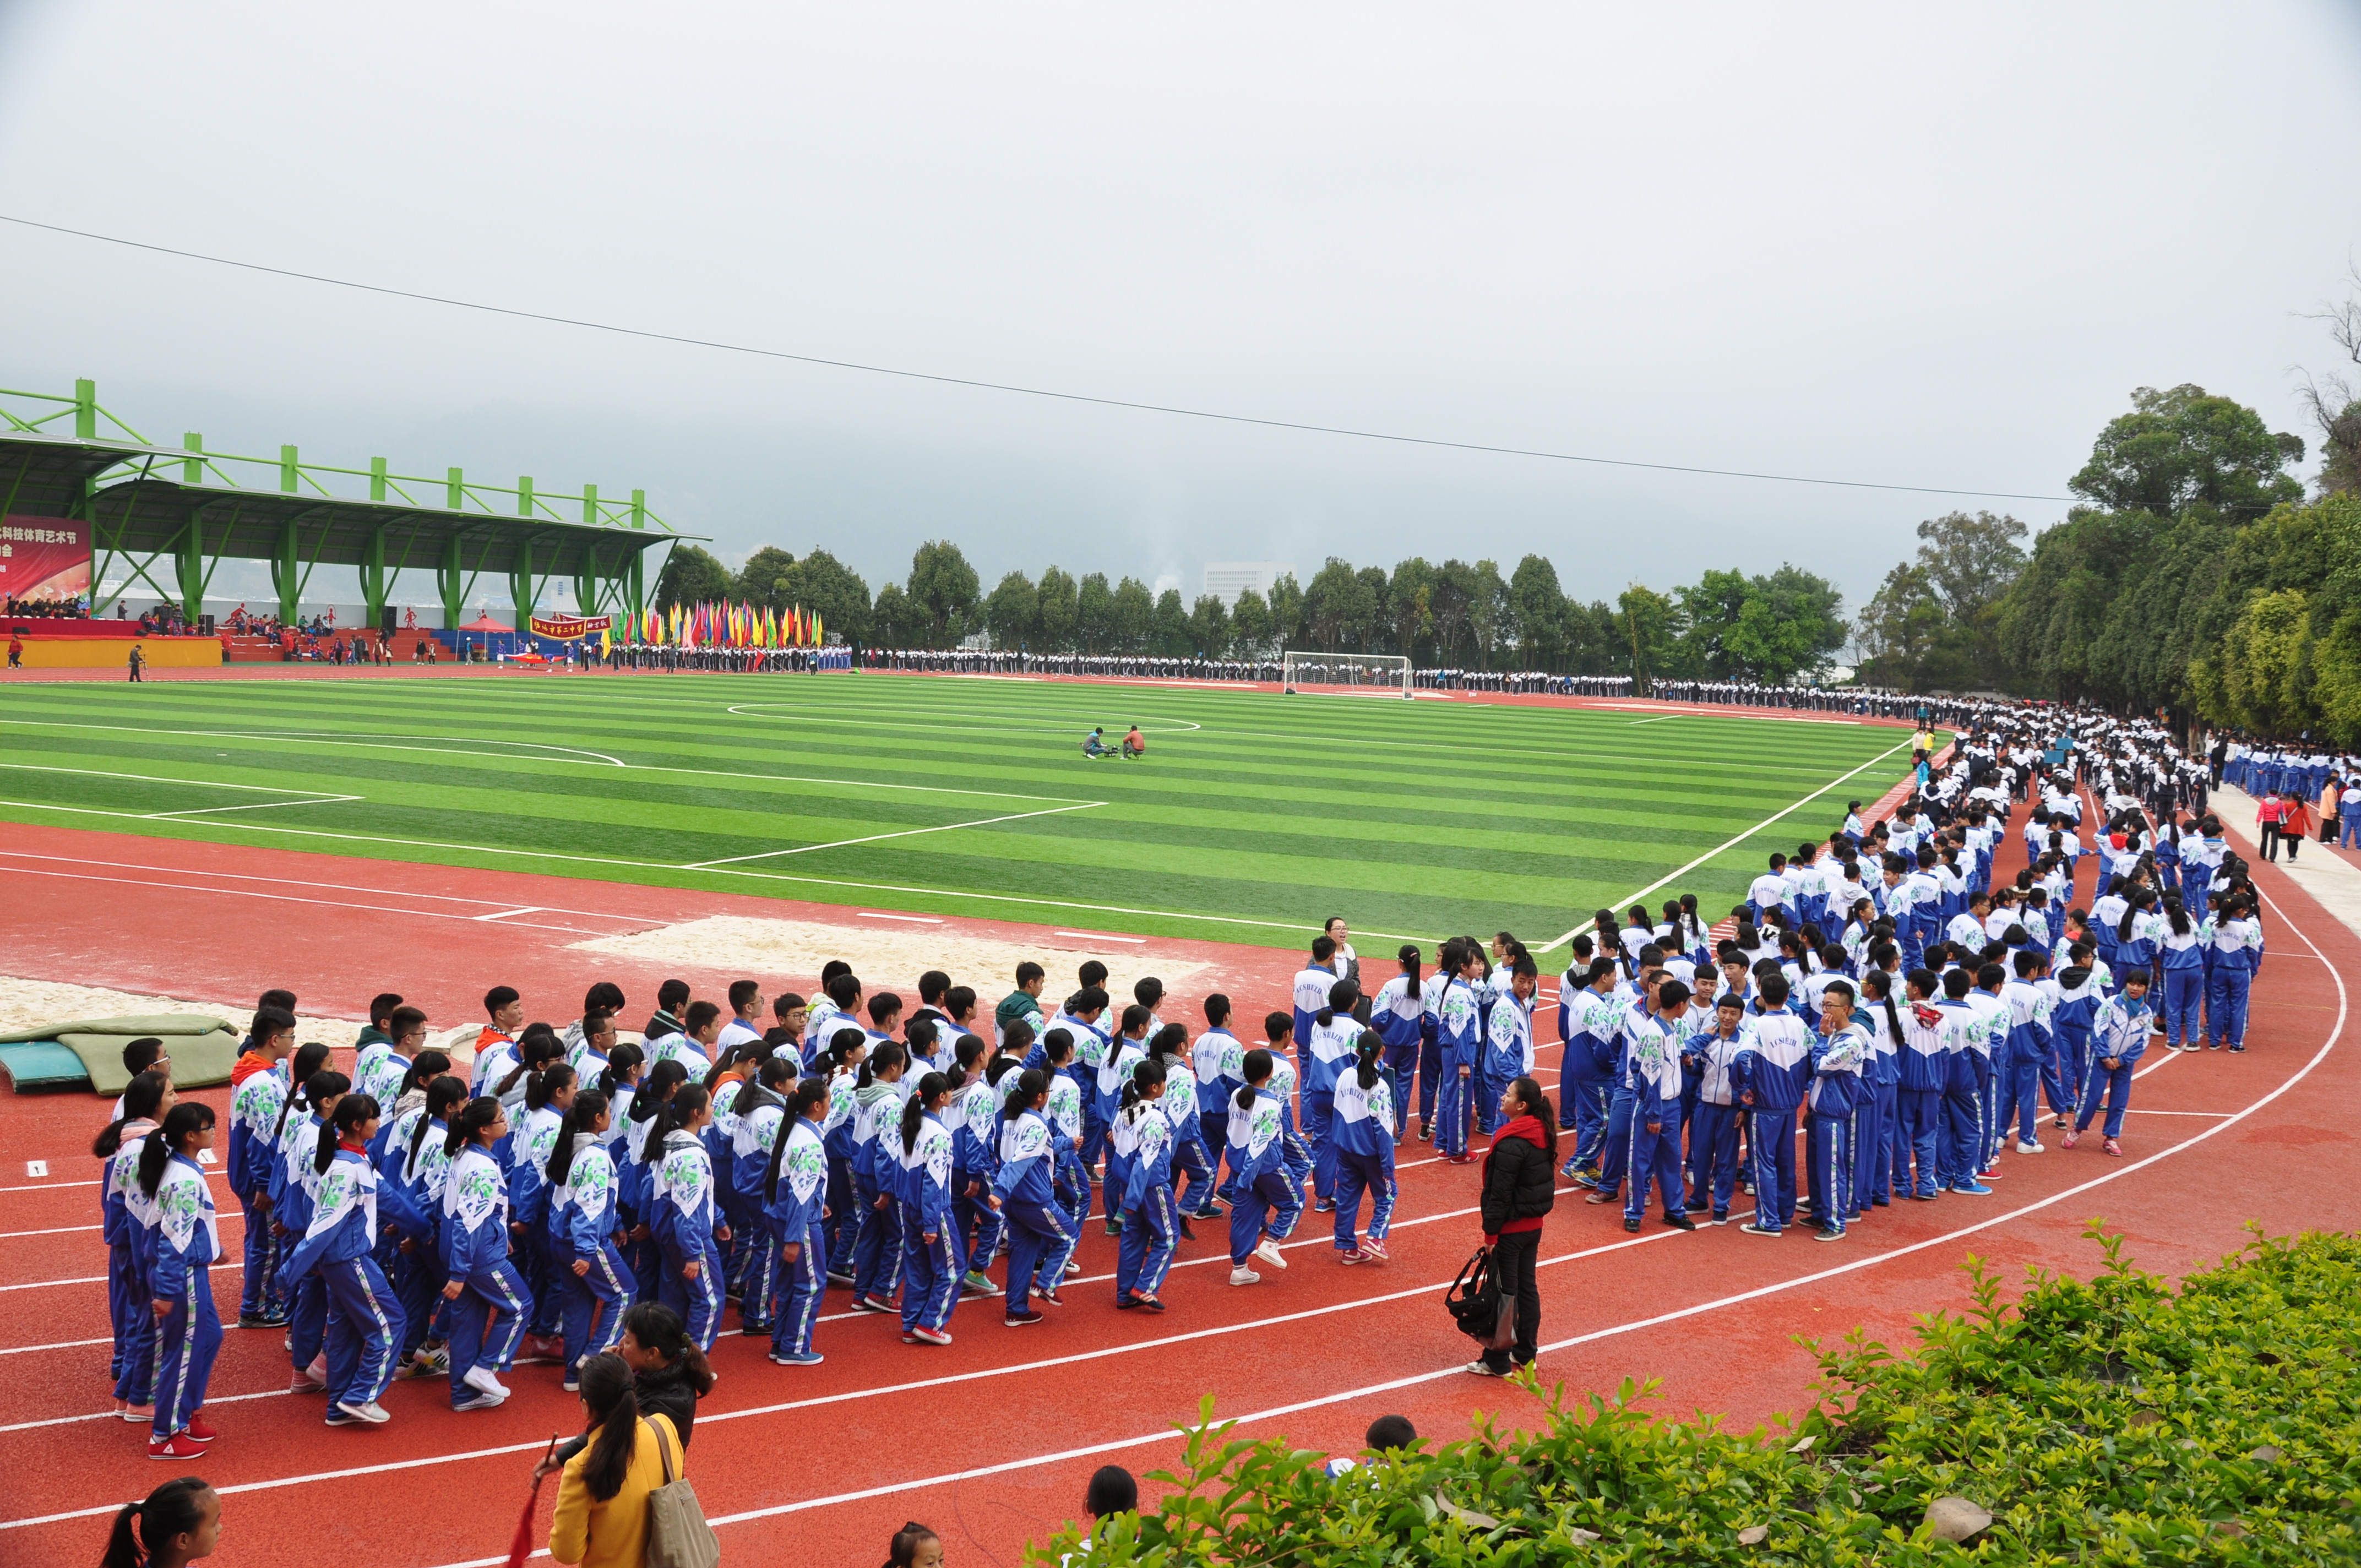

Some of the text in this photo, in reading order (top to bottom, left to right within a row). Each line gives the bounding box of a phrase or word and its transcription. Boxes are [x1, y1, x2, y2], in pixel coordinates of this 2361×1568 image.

[0, 526, 77, 545] 科技体育艺术节
